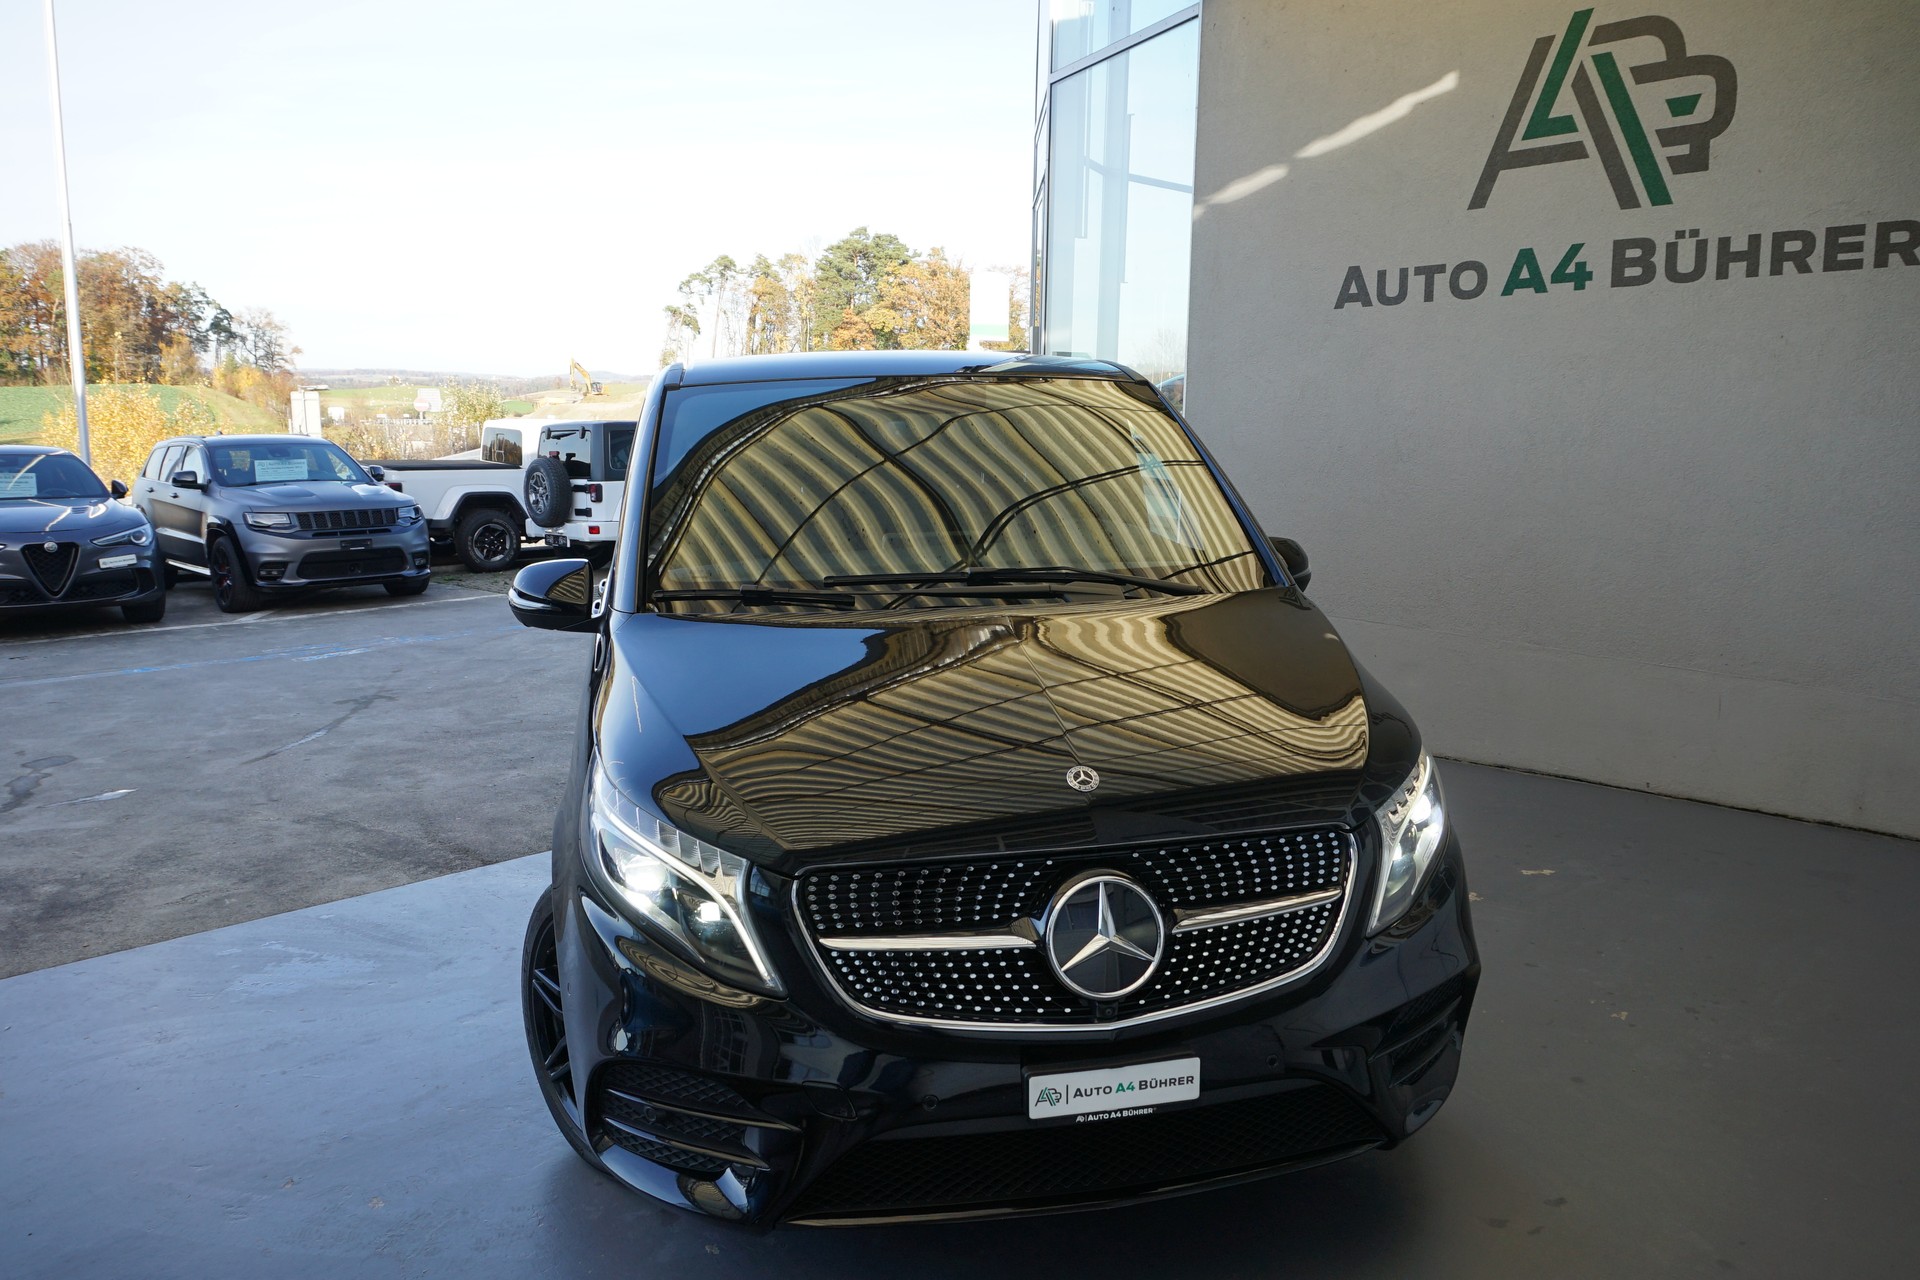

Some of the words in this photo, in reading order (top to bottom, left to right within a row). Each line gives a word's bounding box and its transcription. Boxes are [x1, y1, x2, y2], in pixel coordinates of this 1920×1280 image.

[1333, 260, 1489, 310] AUTO
[1500, 242, 1594, 297] A4
[1610, 219, 1920, 289] BÜHRER
[1073, 1085, 1113, 1099] AUTO
[1115, 1081, 1136, 1094] A4
[1138, 1075, 1195, 1091] BÜHRER
[1087, 1113, 1110, 1121] AUTO
[1110, 1111, 1122, 1119] A4
